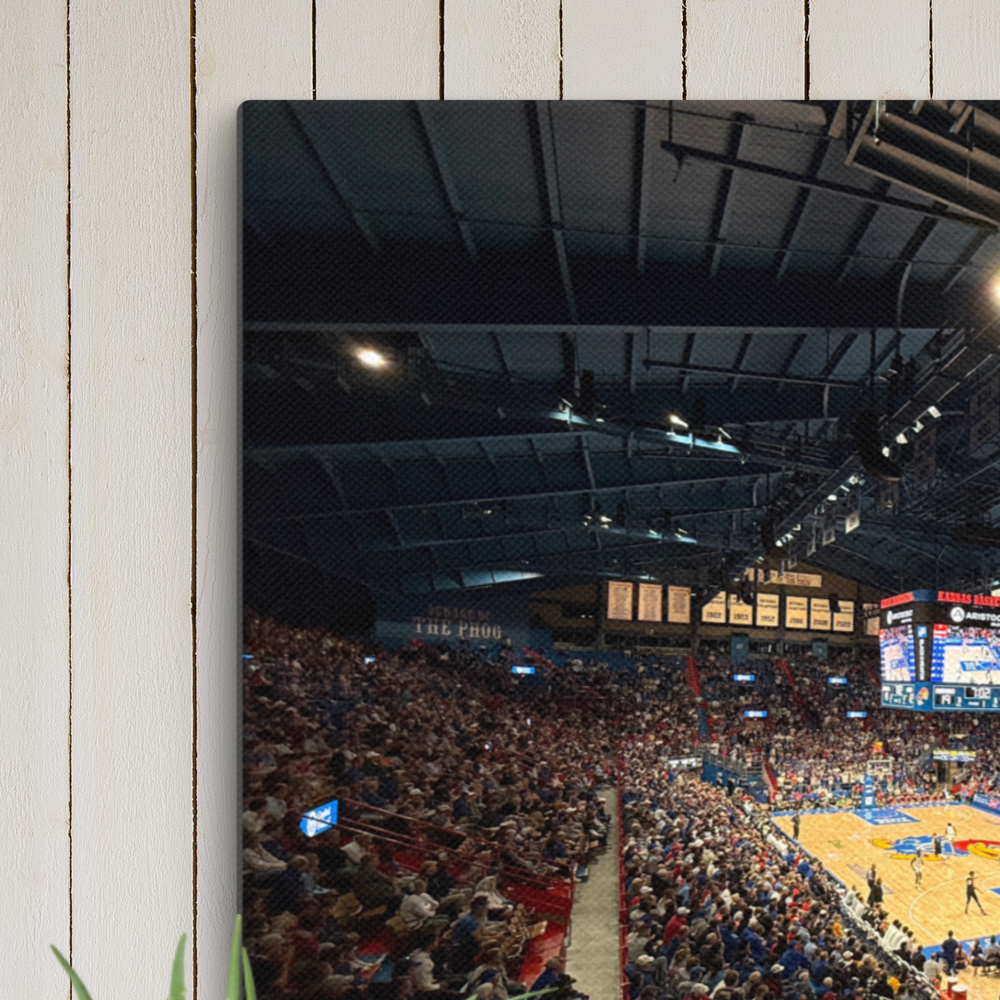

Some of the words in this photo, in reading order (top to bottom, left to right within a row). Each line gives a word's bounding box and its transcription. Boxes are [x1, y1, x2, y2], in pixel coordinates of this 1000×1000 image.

[937, 590, 972, 604] KANSAS
[413, 615, 452, 636] THE
[458, 619, 503, 640] PHOG
